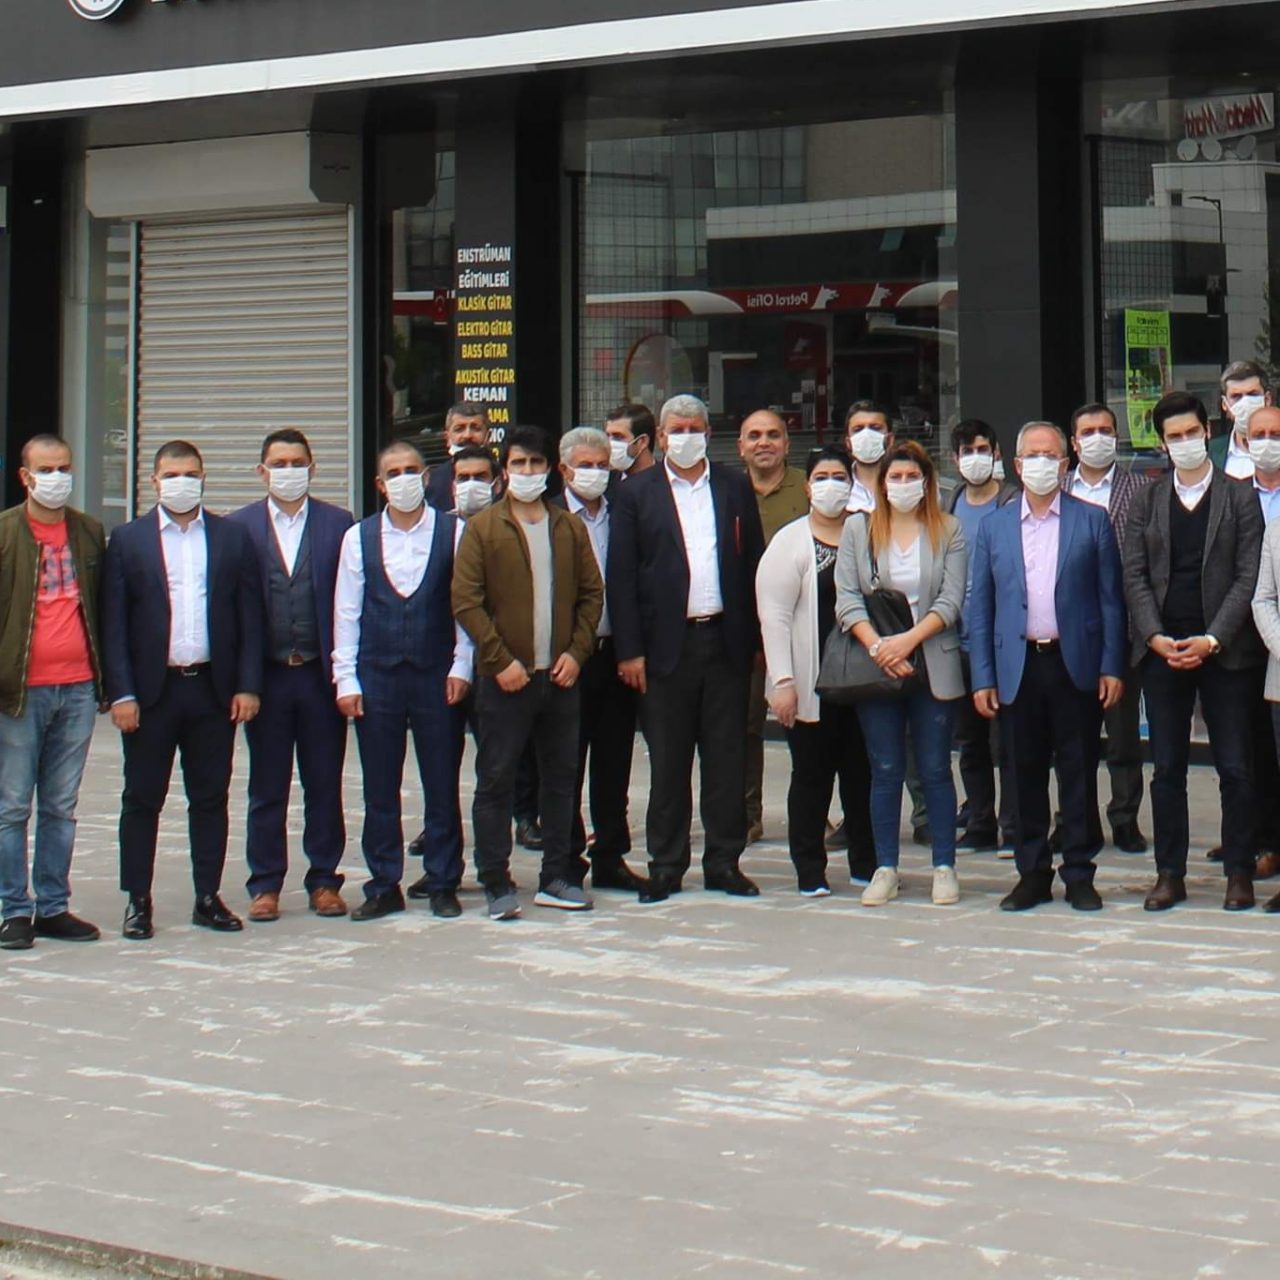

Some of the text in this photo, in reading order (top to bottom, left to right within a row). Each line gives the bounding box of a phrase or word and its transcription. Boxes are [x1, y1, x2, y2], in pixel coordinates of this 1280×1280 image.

[457, 243, 511, 263] ENSTRÜMAN
[458, 269, 510, 288] EĞİTİMLERİ
[457, 293, 512, 311] KLASİK GİTAR
[457, 319, 512, 336] ELEKTRO GİTAR
[462, 342, 508, 358] BASS GİTAR
[455, 367, 515, 384] AKUSTİK GİTAR
[463, 386, 507, 401] KEMAN
